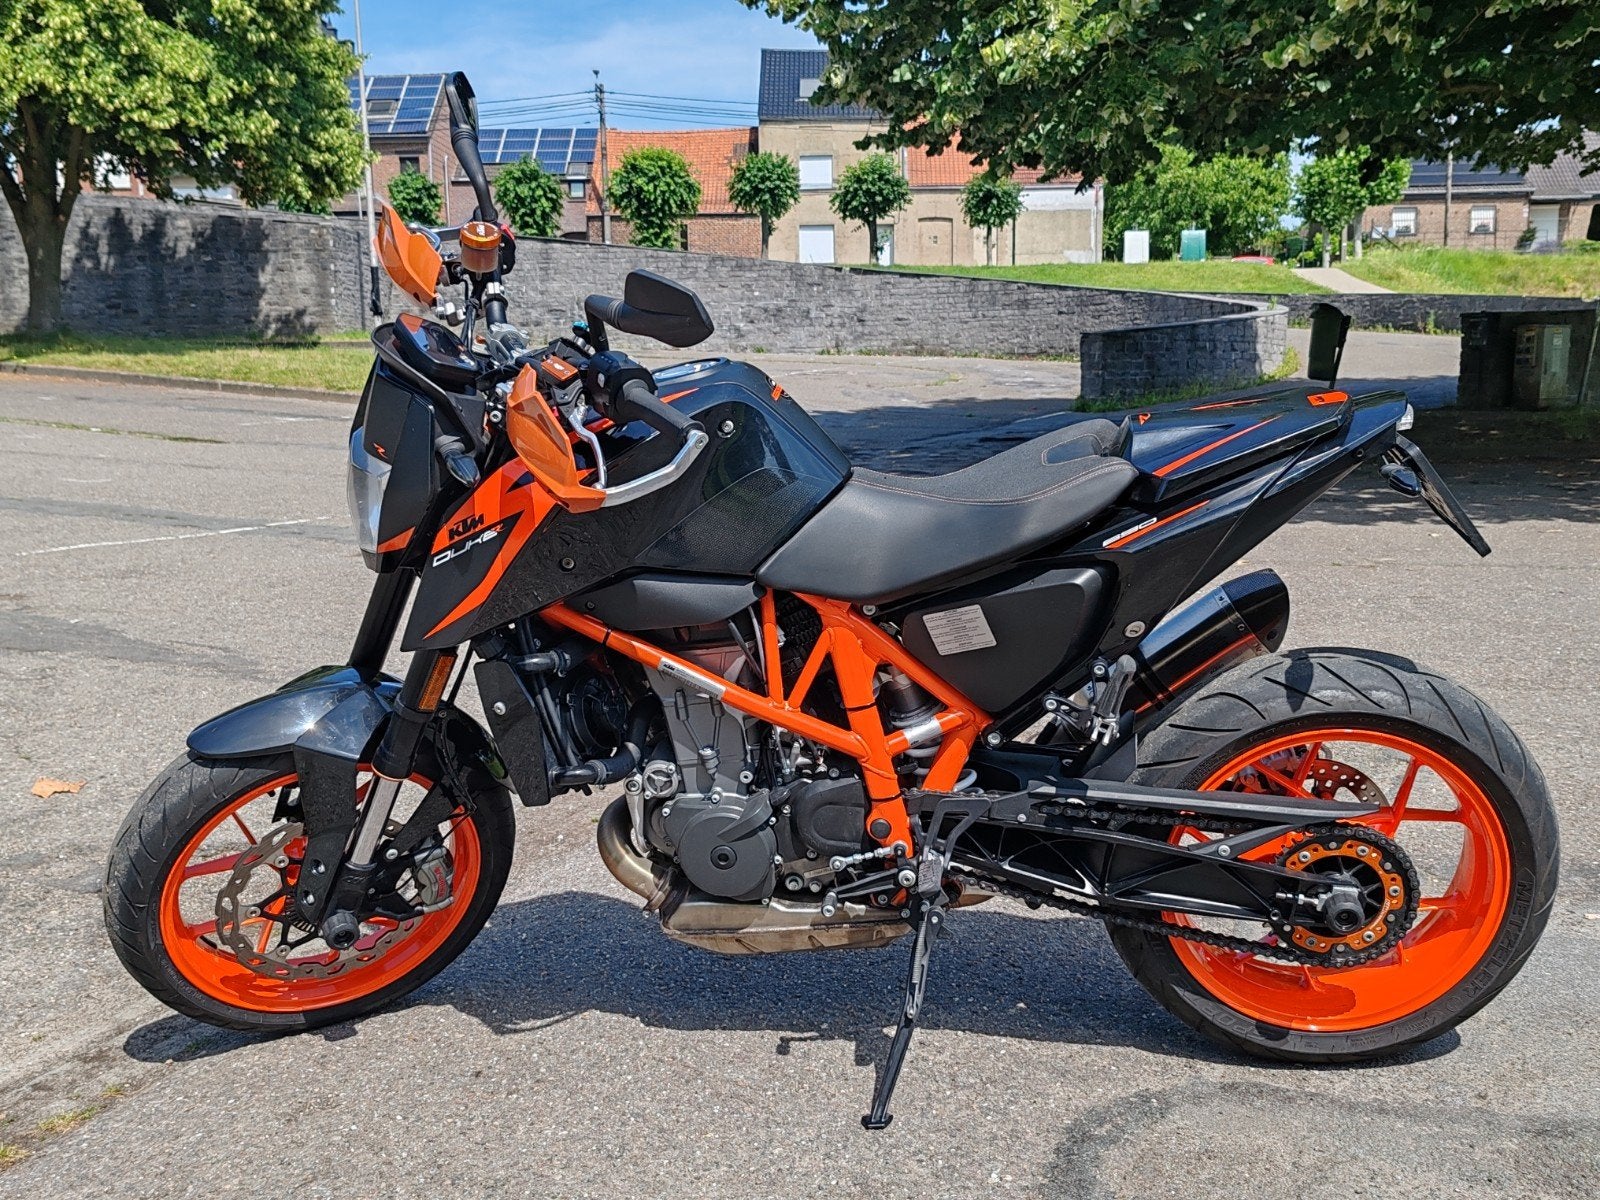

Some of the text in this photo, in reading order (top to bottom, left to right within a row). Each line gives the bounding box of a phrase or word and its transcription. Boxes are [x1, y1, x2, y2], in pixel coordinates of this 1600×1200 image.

[448, 513, 485, 541] KTM
[432, 529, 498, 568] DUKE
[1465, 880, 1535, 998] METZELER
